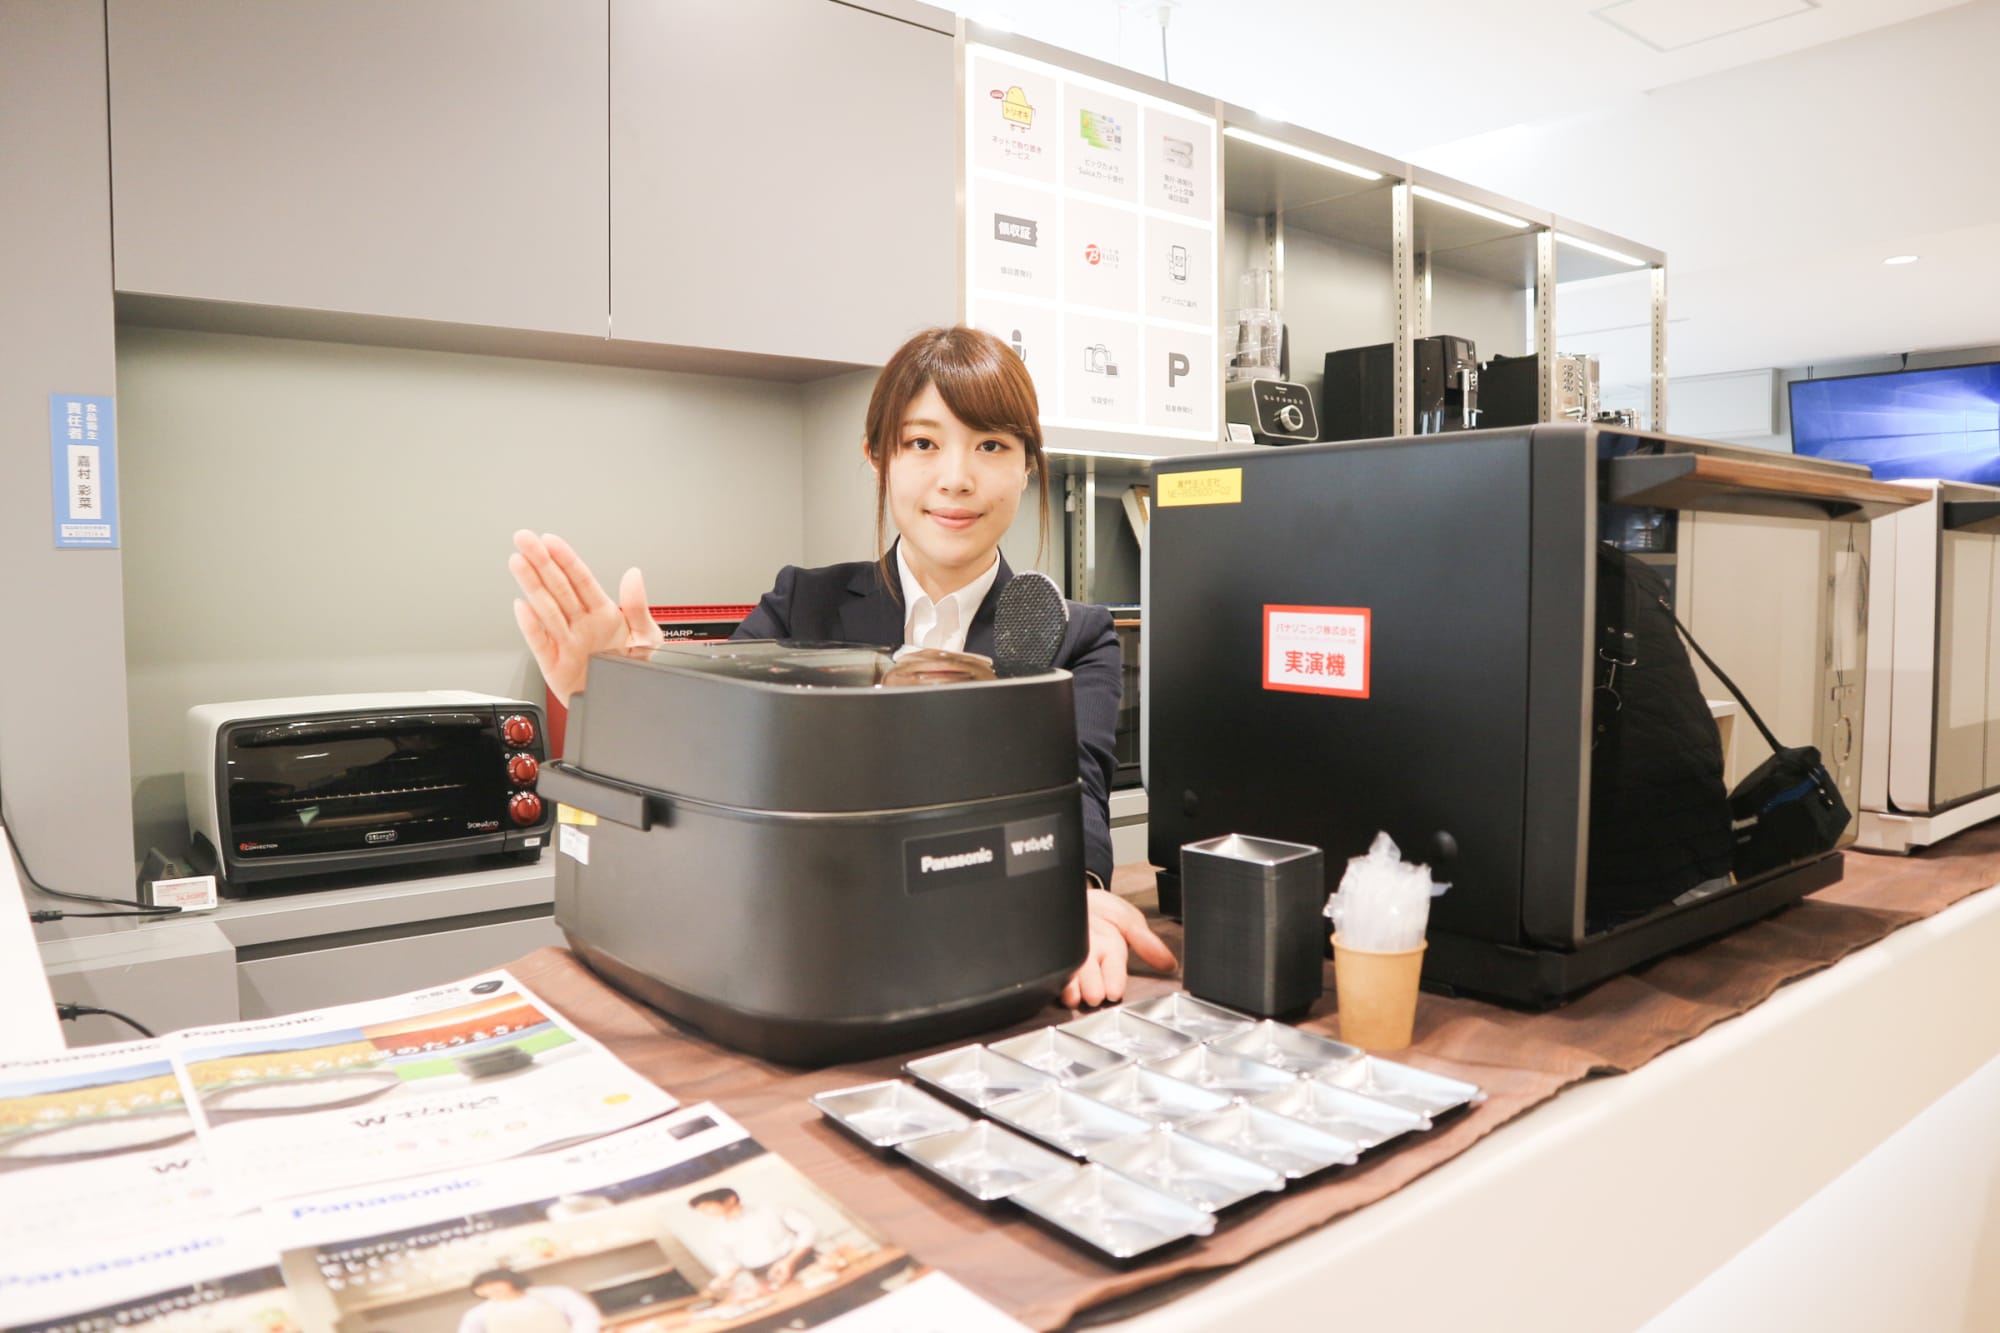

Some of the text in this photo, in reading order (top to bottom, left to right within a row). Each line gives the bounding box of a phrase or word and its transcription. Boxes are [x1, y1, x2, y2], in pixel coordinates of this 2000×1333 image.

[1005, 149, 1031, 161] サービス
[1168, 352, 1190, 388] P
[1275, 623, 1357, 637] パナソニック株式会社
[1284, 649, 1347, 678] 実演機
[920, 847, 994, 873] Panasonic
[182, 1014, 325, 1039] Panasonic
[291, 1178, 484, 1220] Panasonic
